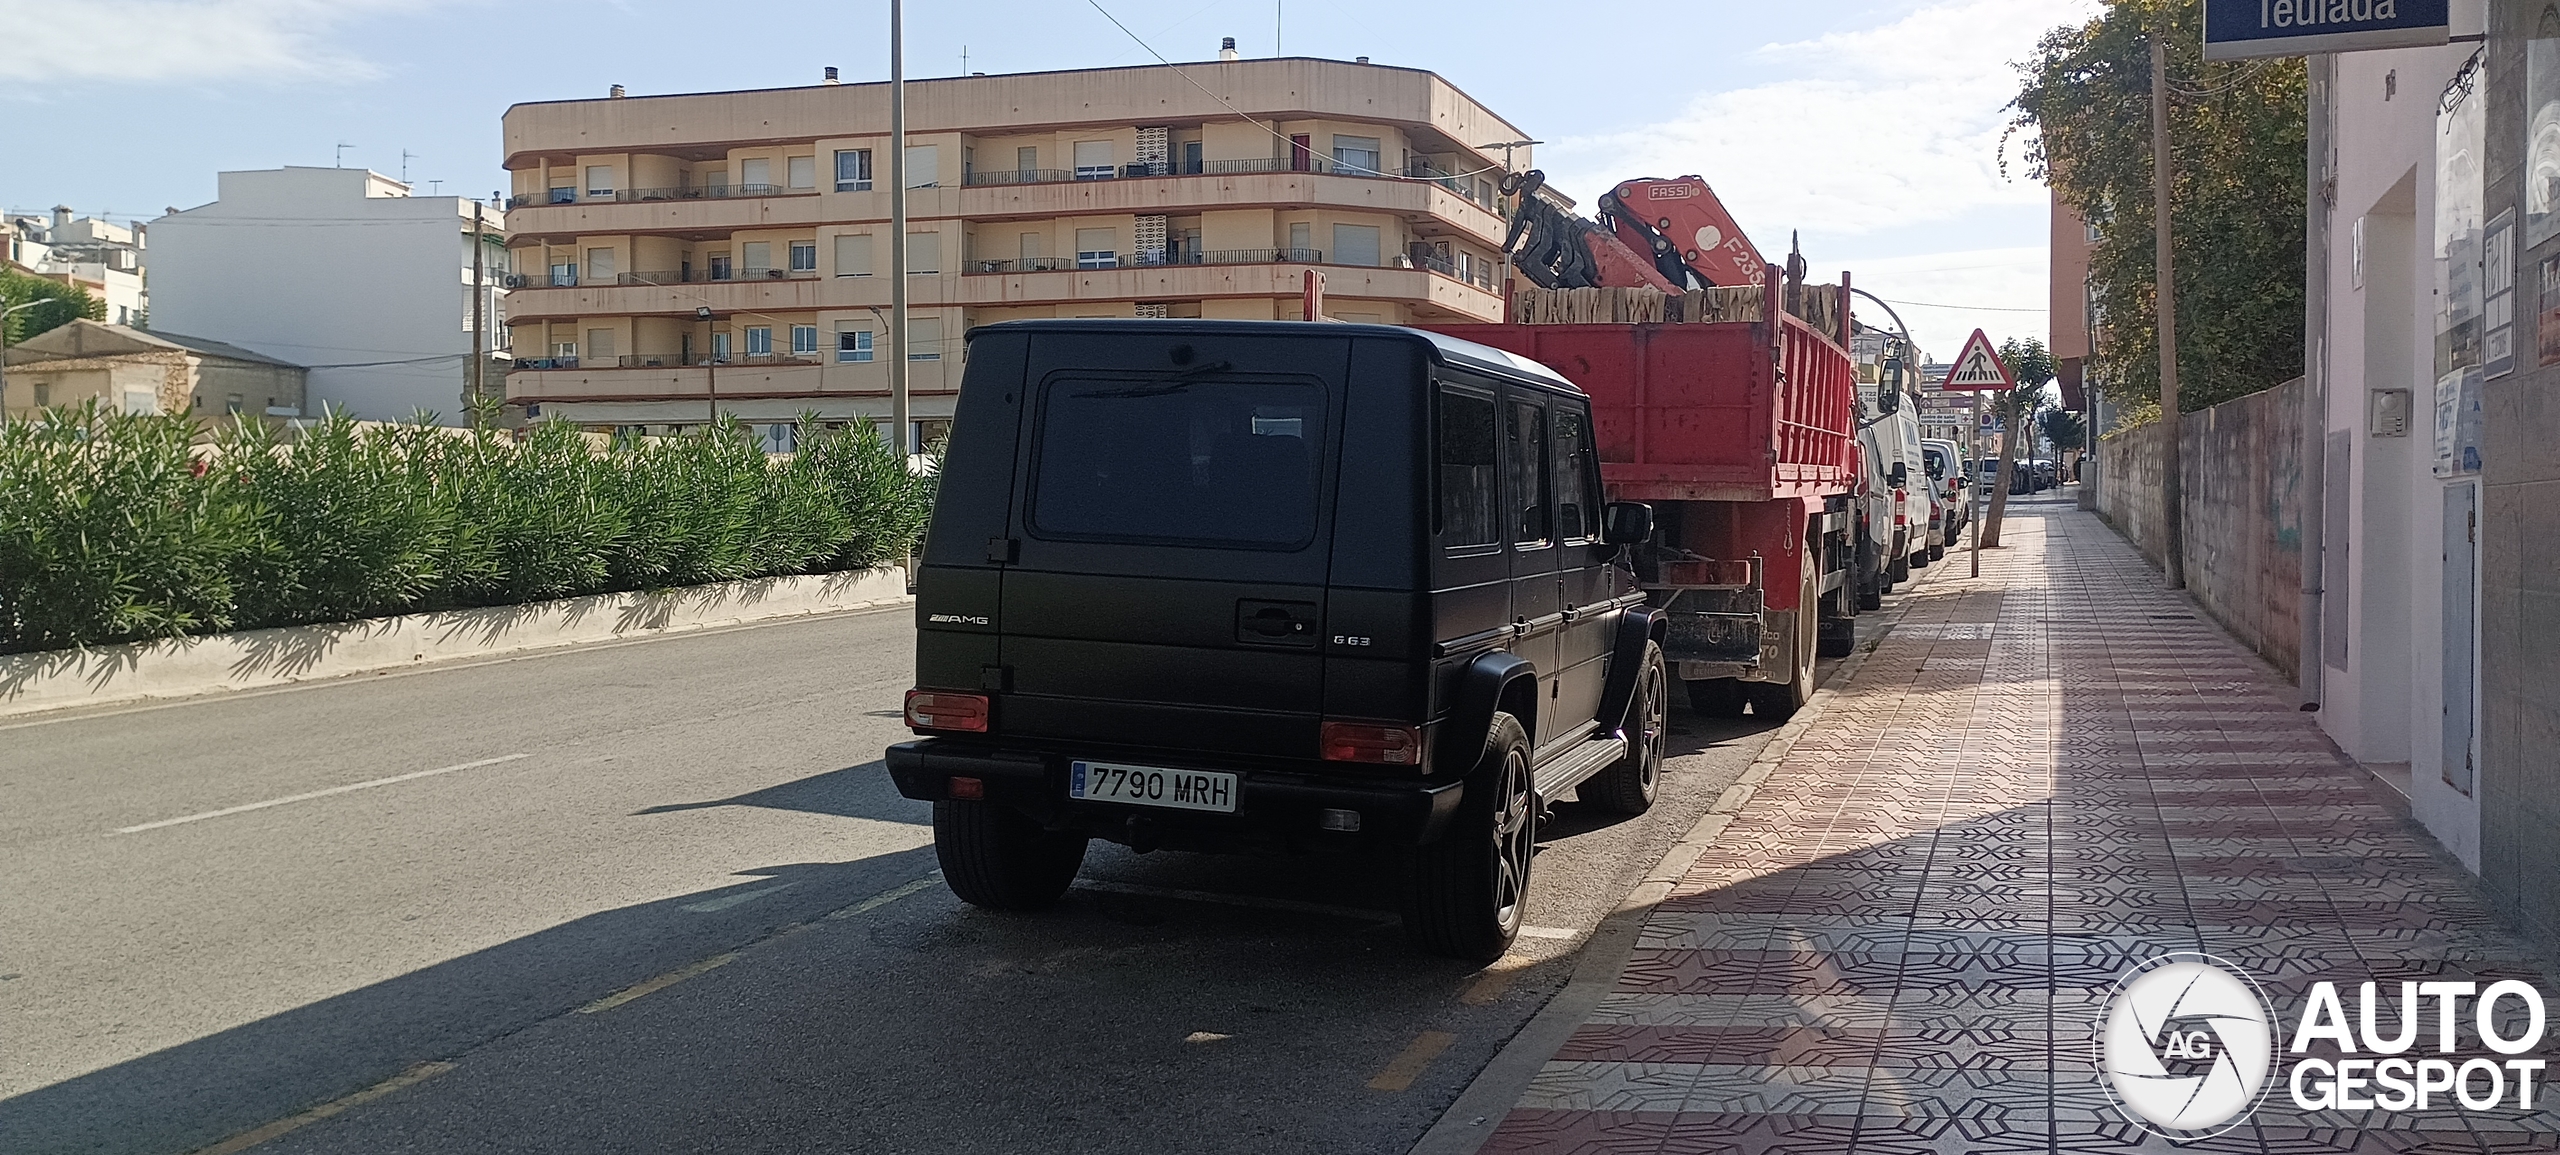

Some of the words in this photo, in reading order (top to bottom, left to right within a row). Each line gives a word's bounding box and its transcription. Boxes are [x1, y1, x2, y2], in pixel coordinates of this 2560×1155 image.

[1651, 186, 1688, 197] FASSI
[1723, 236, 1766, 284] F235
[948, 615, 989, 625] AMG
[1333, 635, 1345, 644] G
[1092, 767, 1164, 800] 7790
[1174, 774, 1229, 806] MRH
